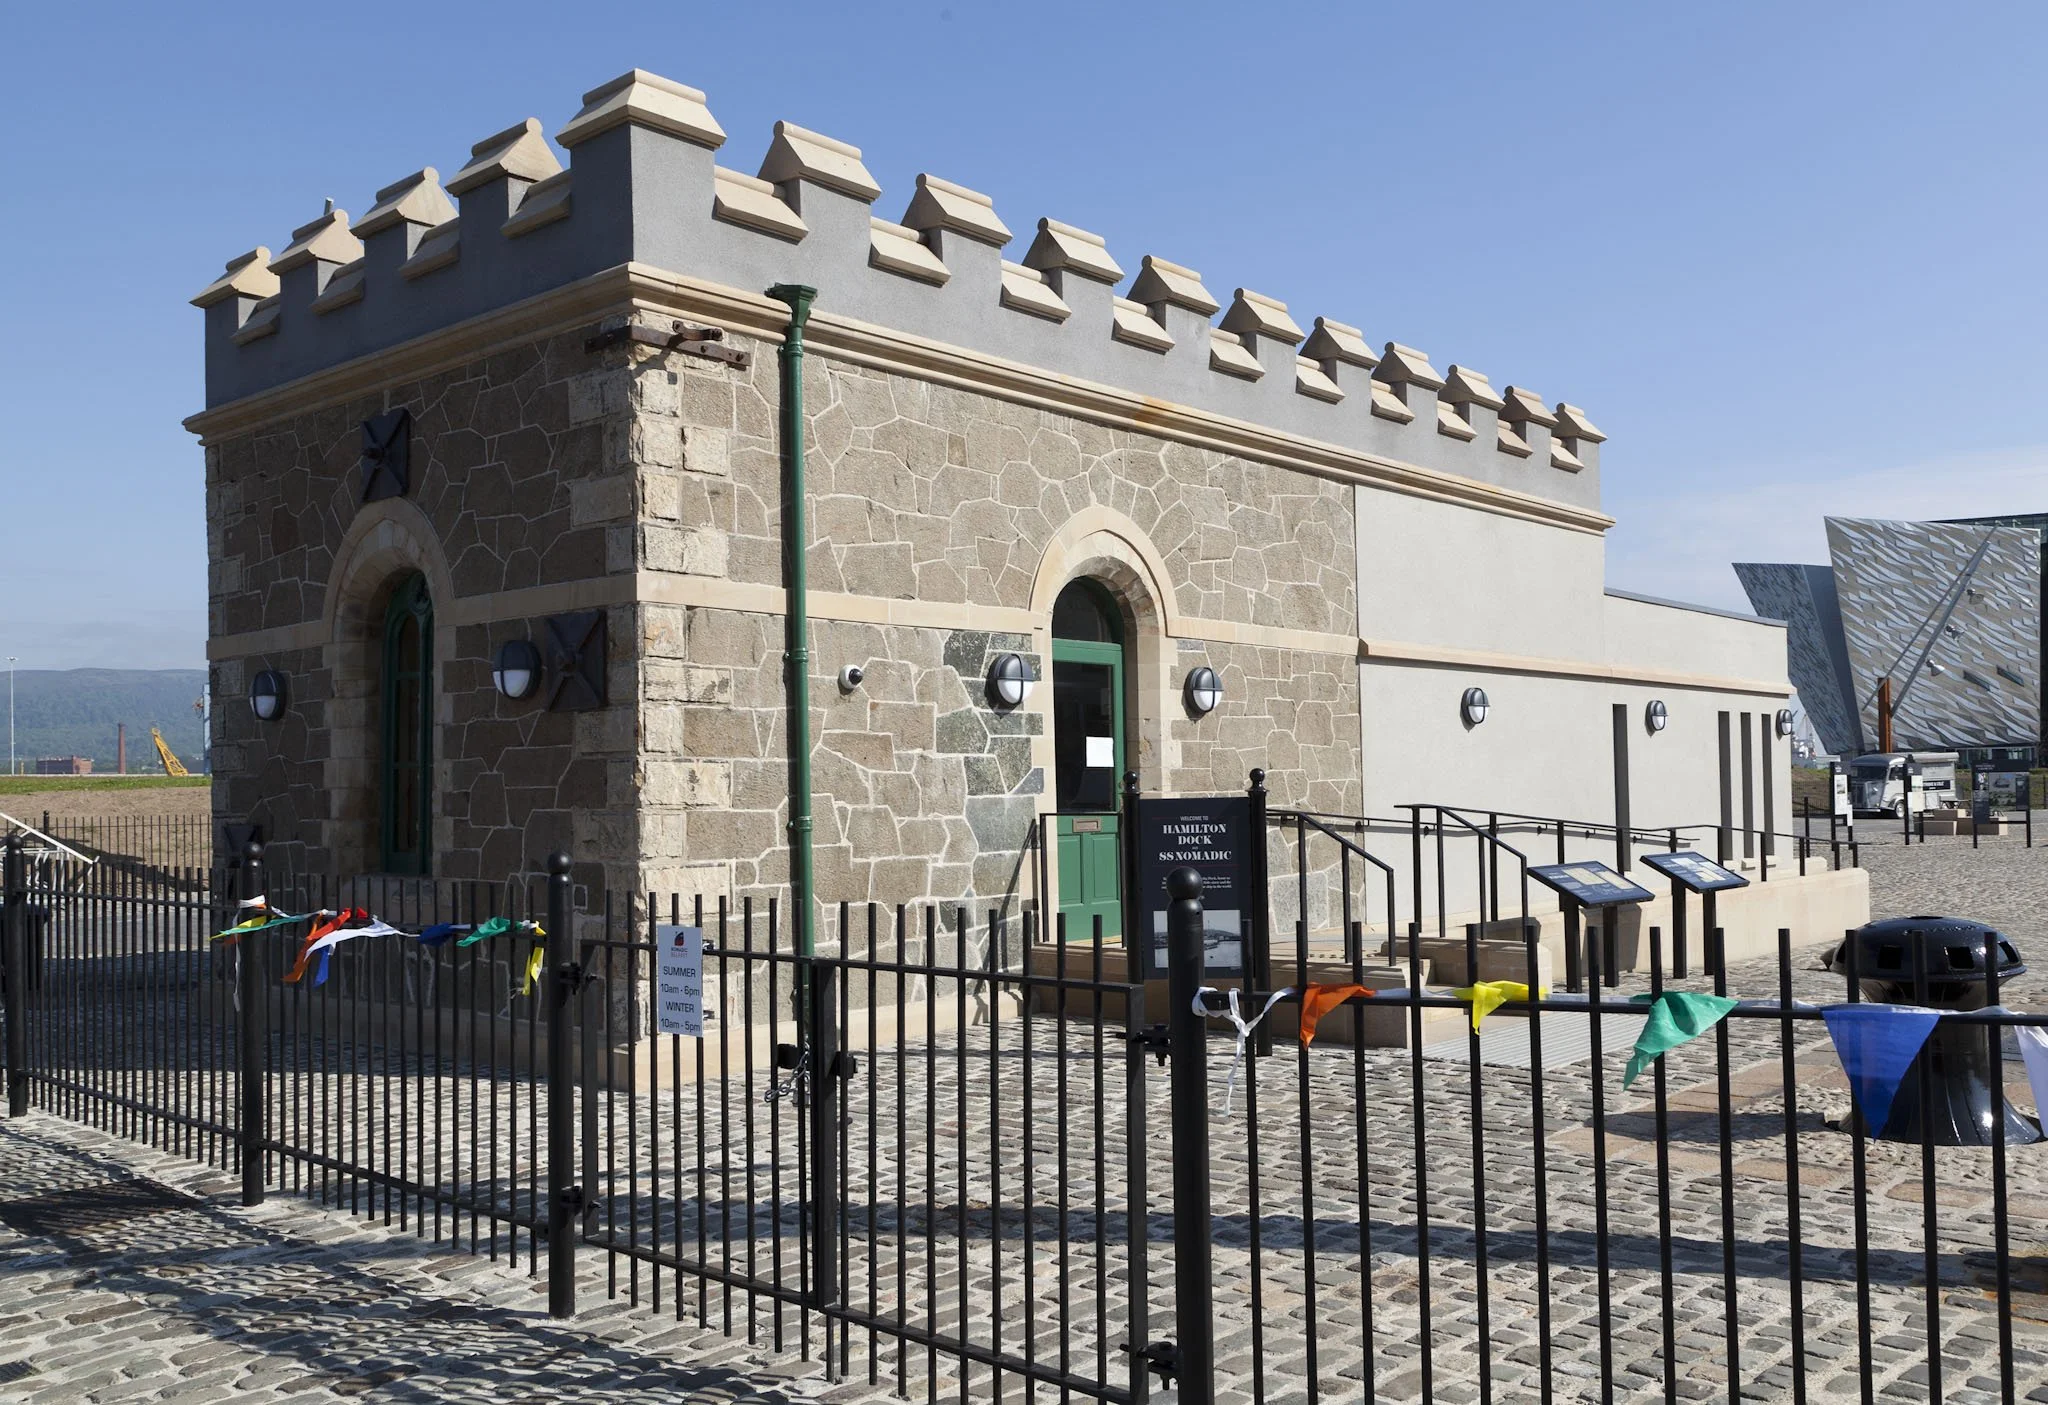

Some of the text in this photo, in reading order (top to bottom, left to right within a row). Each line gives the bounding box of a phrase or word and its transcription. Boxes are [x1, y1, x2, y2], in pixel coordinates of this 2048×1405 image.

[1163, 824, 1226, 834] HAMILTON
[1178, 835, 1212, 845] DOCK
[1159, 851, 1232, 861] SS NOMADIC
[663, 965, 696, 978] SUMMER
[661, 983, 679, 993] 10am
[684, 985, 700, 999] 6pm
[665, 1001, 695, 1013] WINTER
[661, 1018, 679, 1029] 10am
[685, 1020, 700, 1032] 5pm
